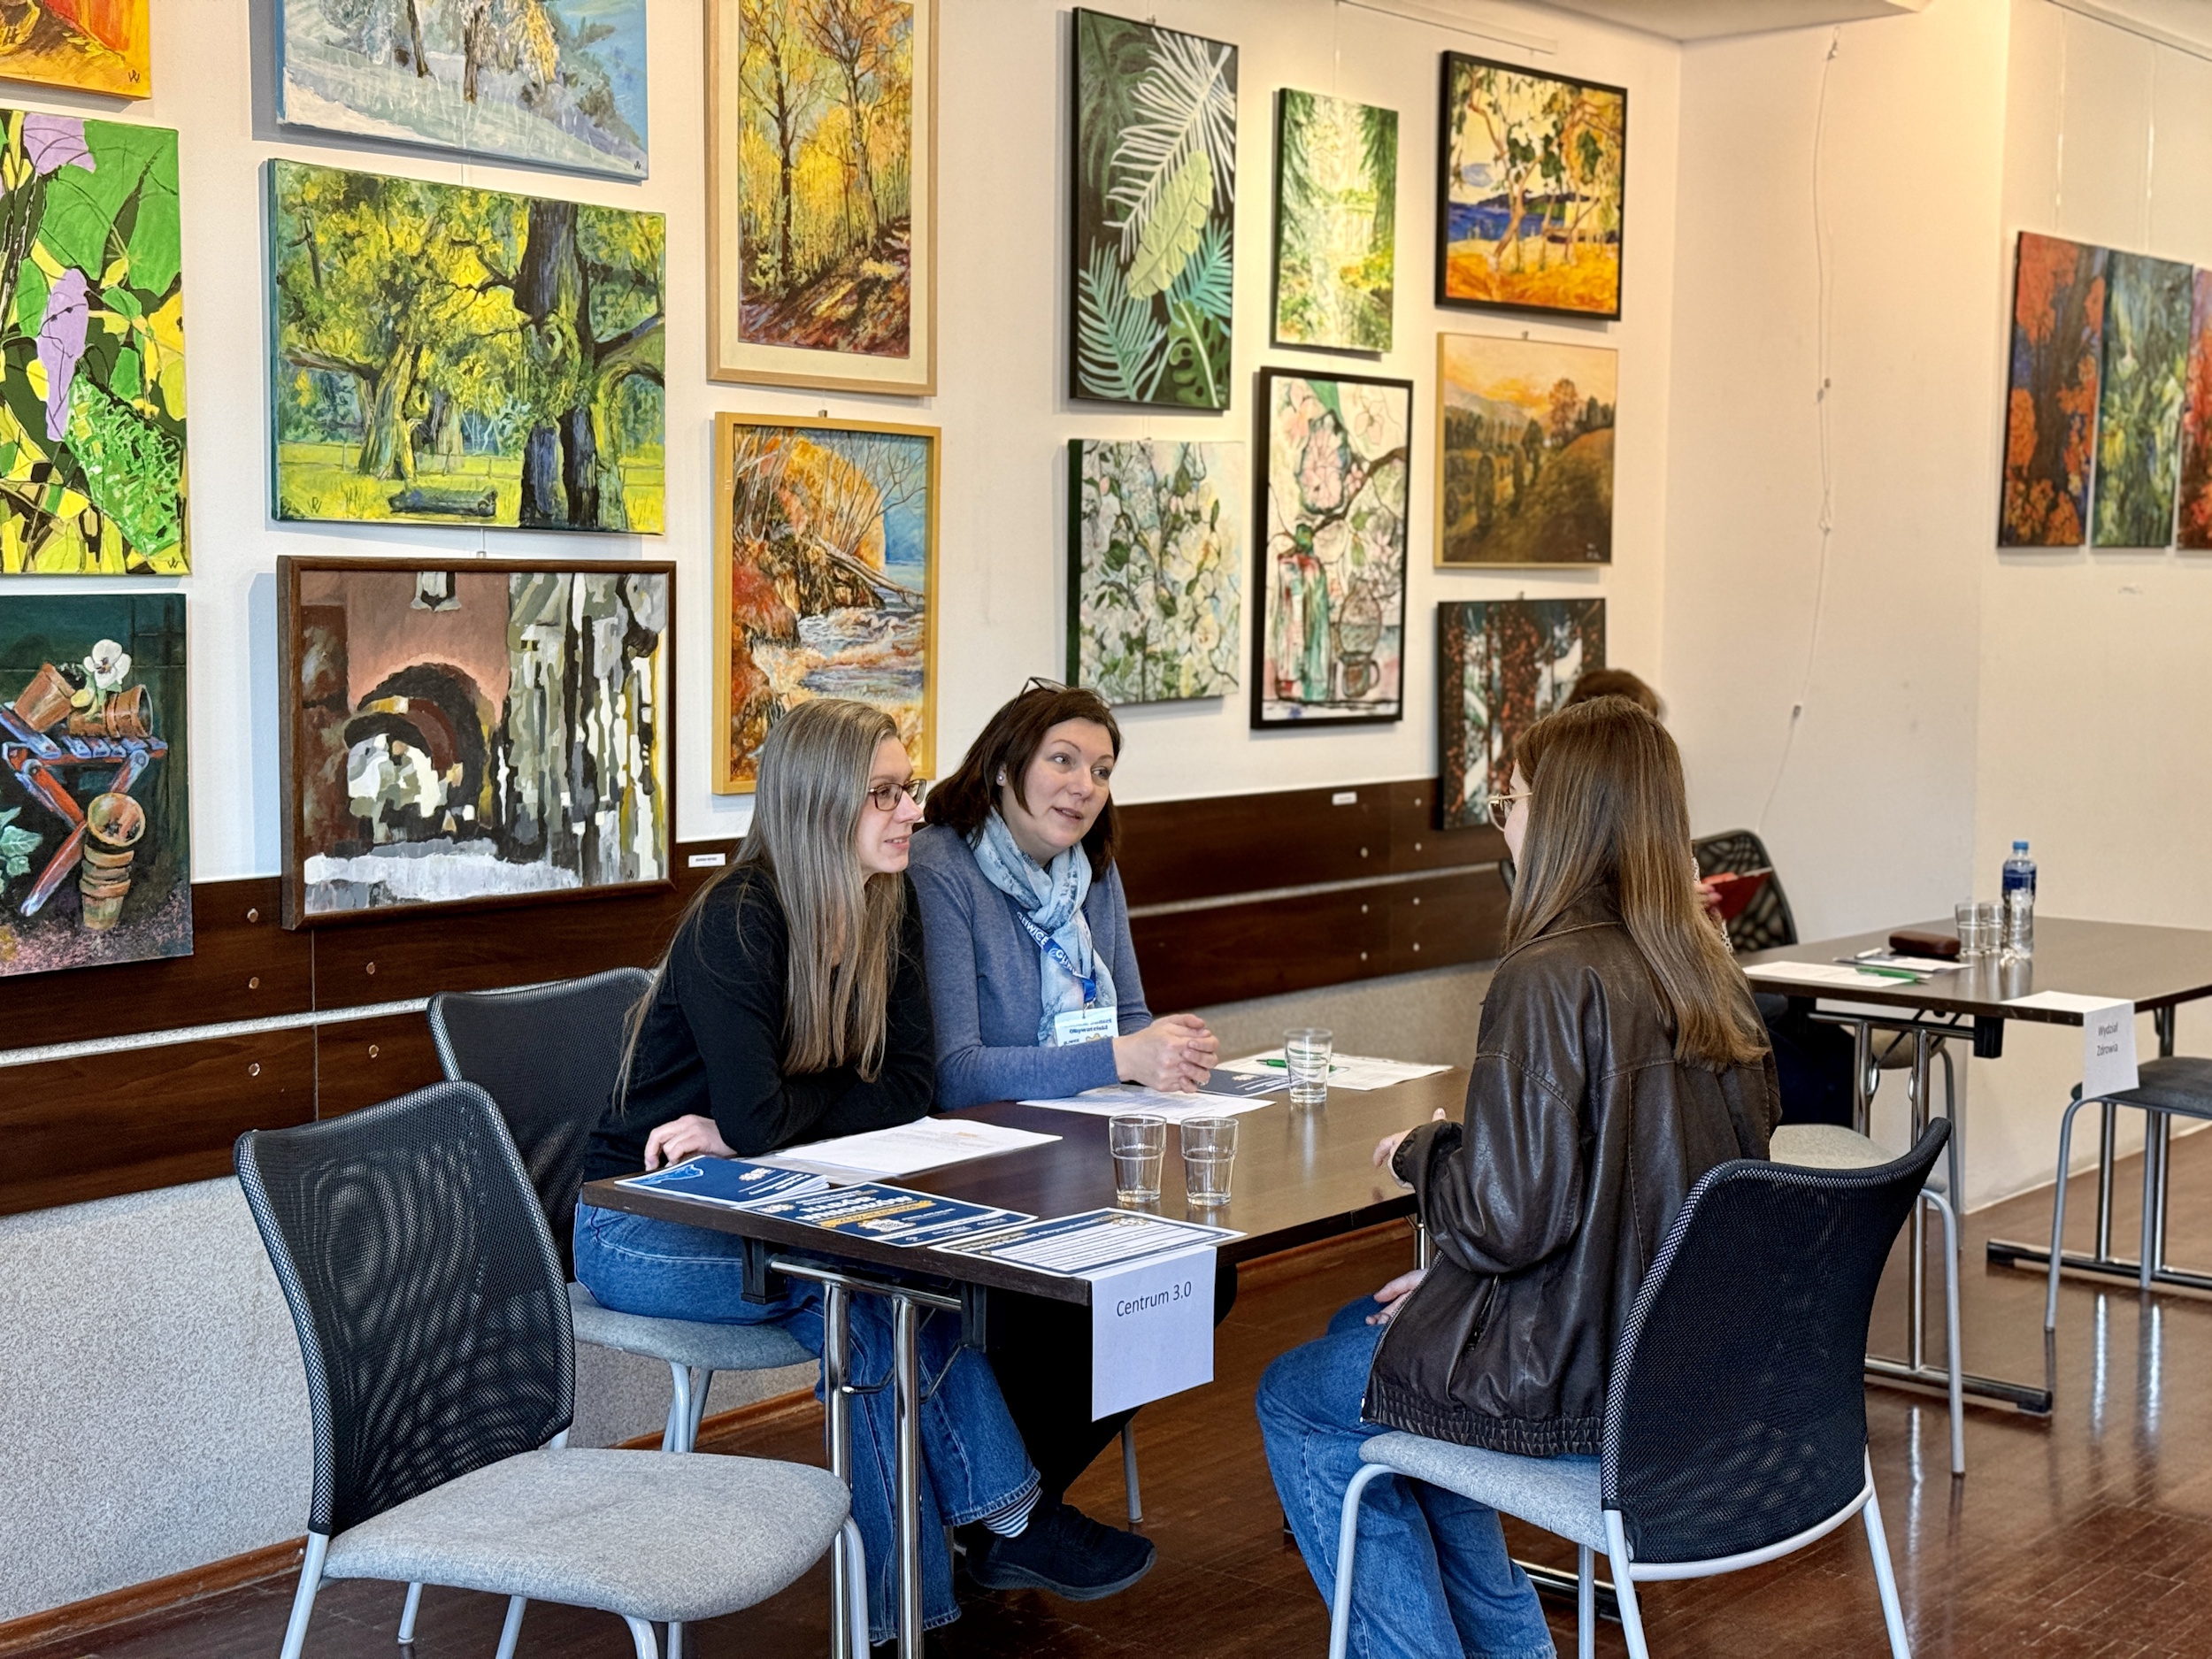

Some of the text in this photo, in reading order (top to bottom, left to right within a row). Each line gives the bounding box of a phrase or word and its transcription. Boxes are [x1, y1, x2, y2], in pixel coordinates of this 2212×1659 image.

[1017, 911, 1049, 946] GLIWICE
[2098, 1021, 2119, 1037] Wydział
[2096, 1043, 2118, 1056] Zdrowia
[1117, 1281, 1192, 1317] Centrum 3.0
